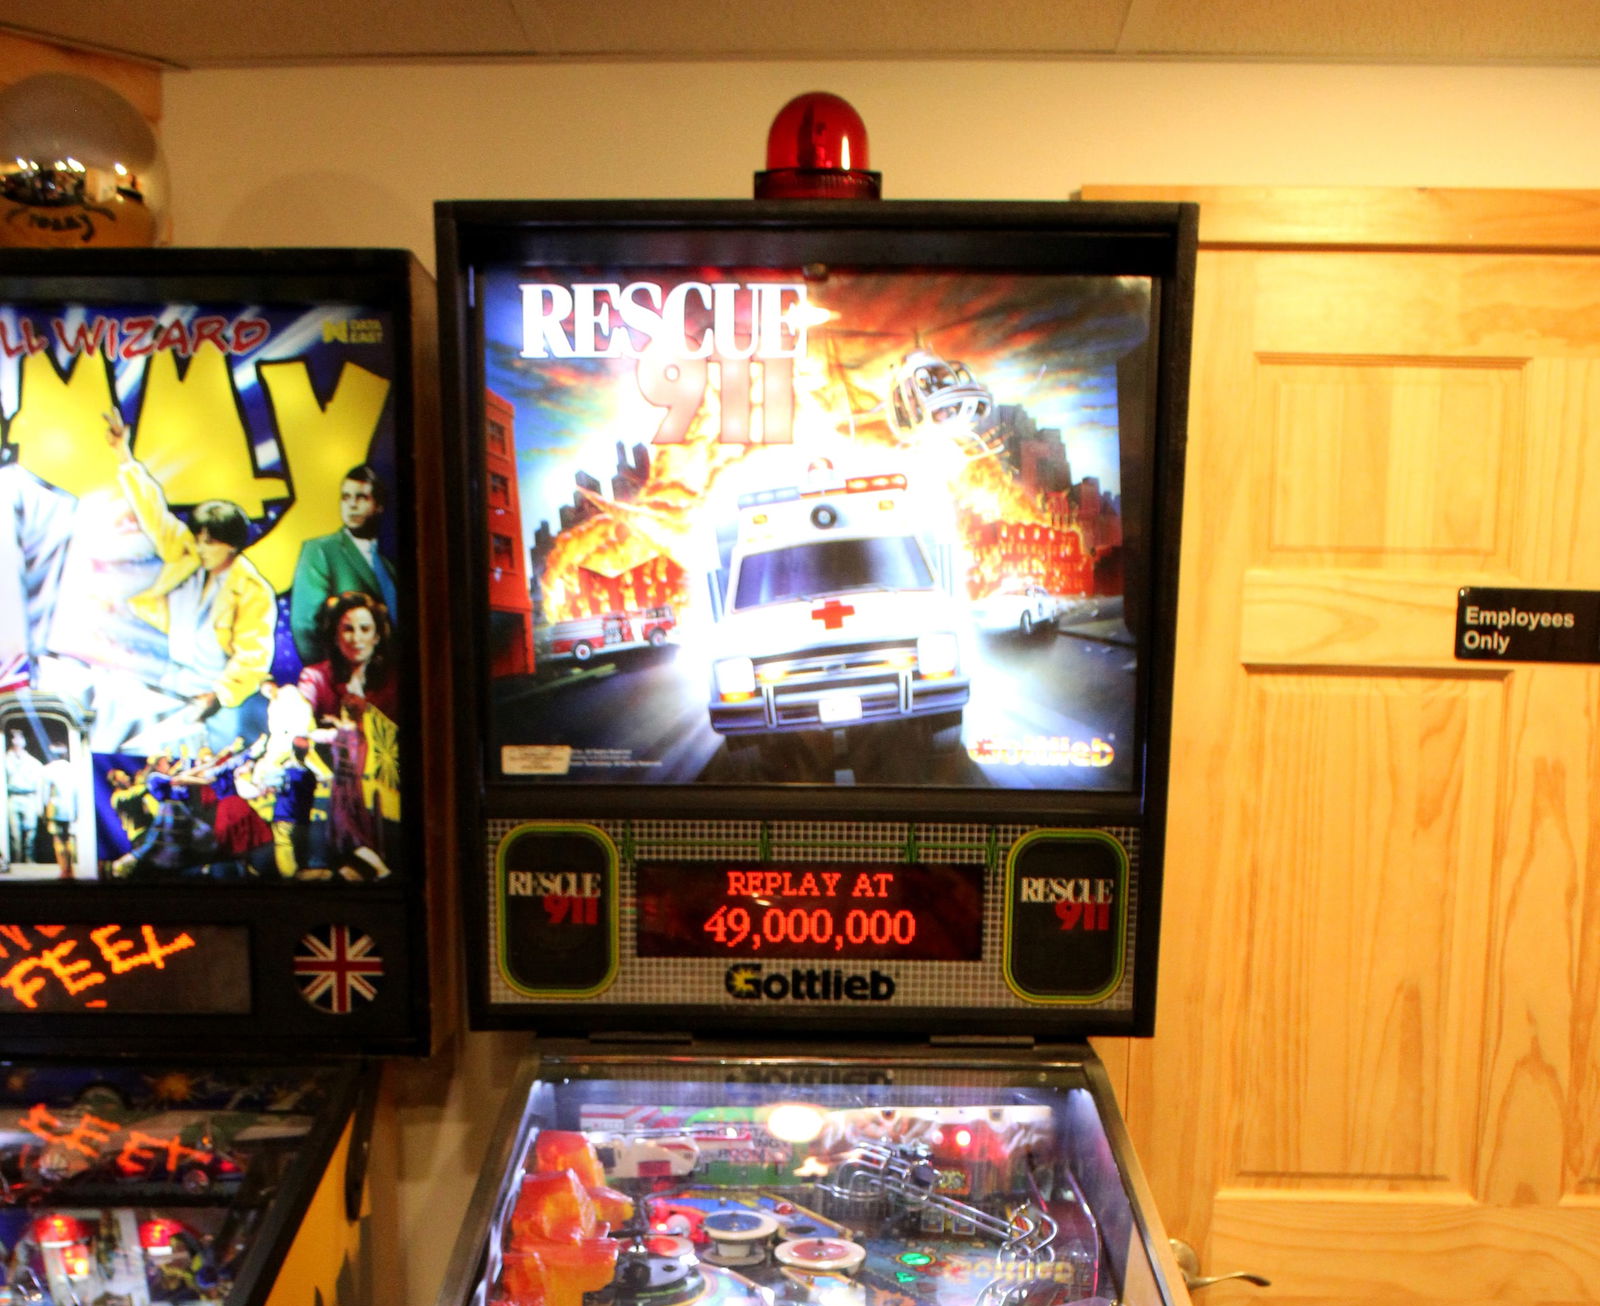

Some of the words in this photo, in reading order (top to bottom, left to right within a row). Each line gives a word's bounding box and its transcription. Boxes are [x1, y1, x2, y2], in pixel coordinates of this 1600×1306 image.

[519, 281, 808, 359] RESCUE
[52, 314, 270, 361] WIZARD
[636, 352, 795, 445] 911
[1465, 606, 1575, 631] Employees
[1463, 630, 1510, 655] Only
[508, 871, 601, 897] RESCUE
[727, 871, 842, 896] REPLAY
[851, 873, 894, 897] AT
[1021, 877, 1113, 904] RESCUE
[543, 894, 599, 925] 911
[1055, 899, 1109, 931] 911
[703, 905, 916, 950] 49,000,000
[724, 963, 896, 1000] Gottlieb
